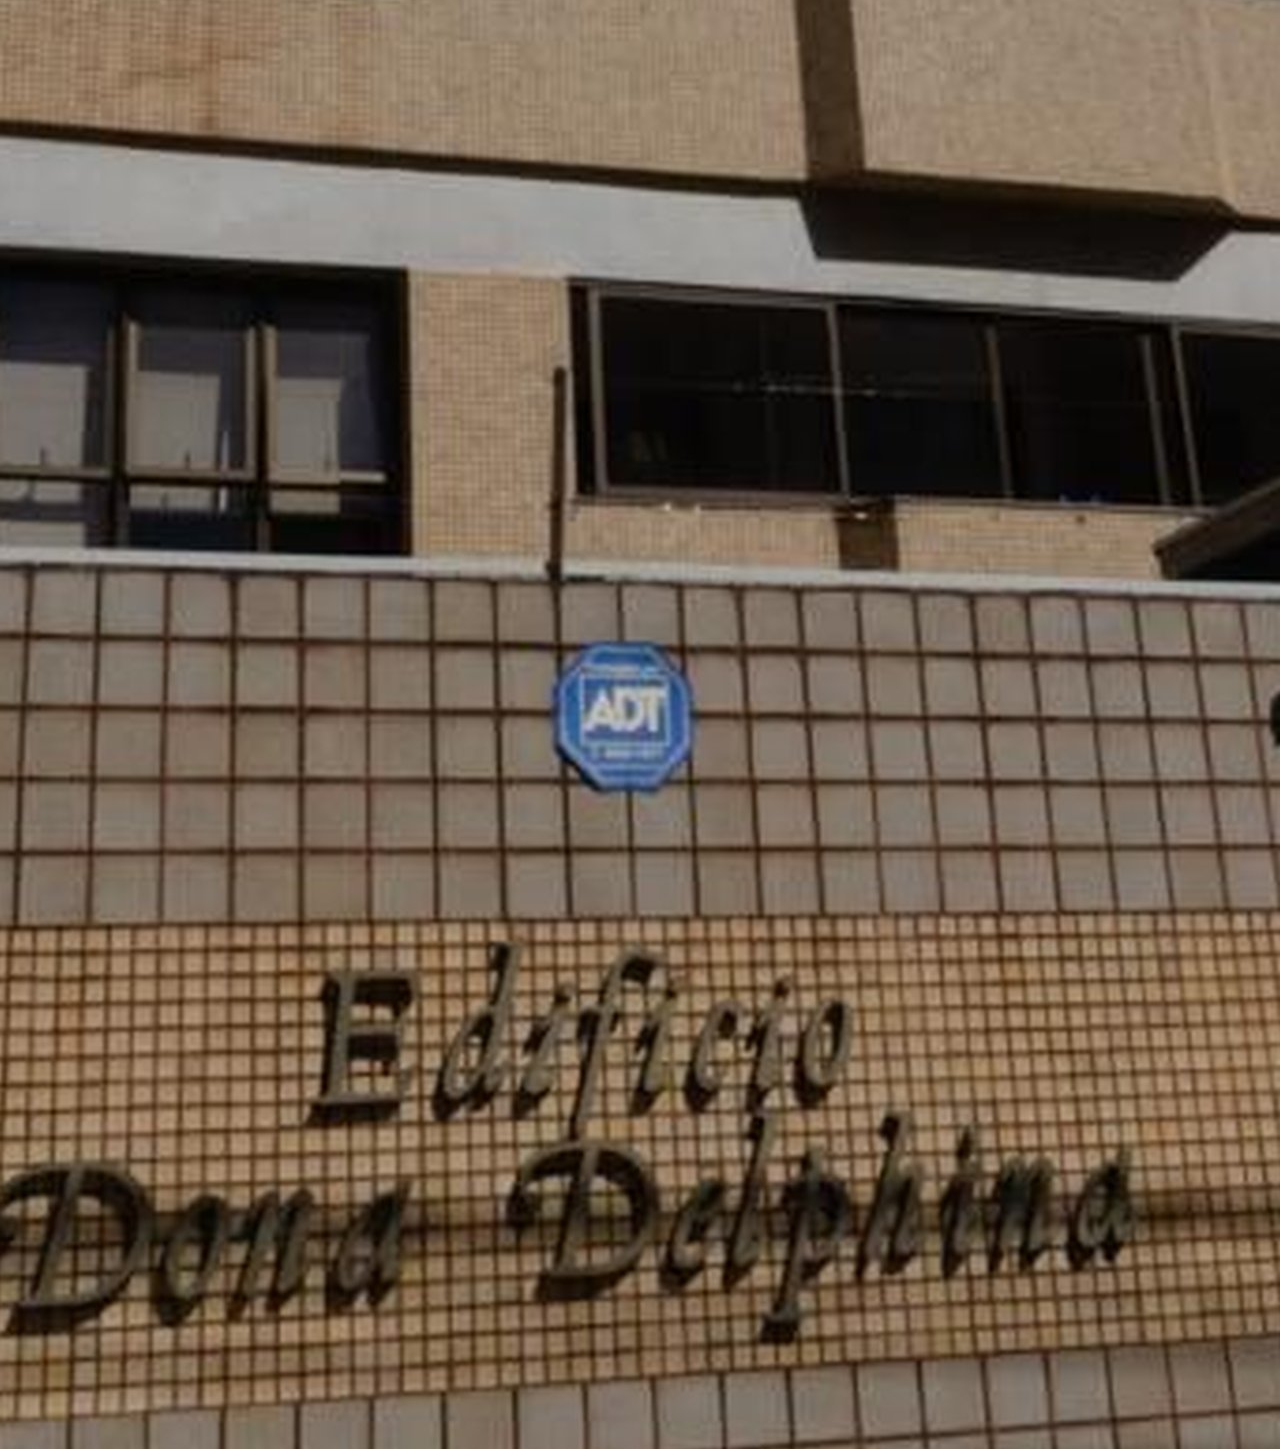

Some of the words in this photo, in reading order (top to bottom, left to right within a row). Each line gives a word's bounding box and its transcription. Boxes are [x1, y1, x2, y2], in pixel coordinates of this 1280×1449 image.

[583, 685, 667, 733] ADT
[314, 941, 852, 1137] Edificio
[506, 1111, 1132, 1339] Delphina
